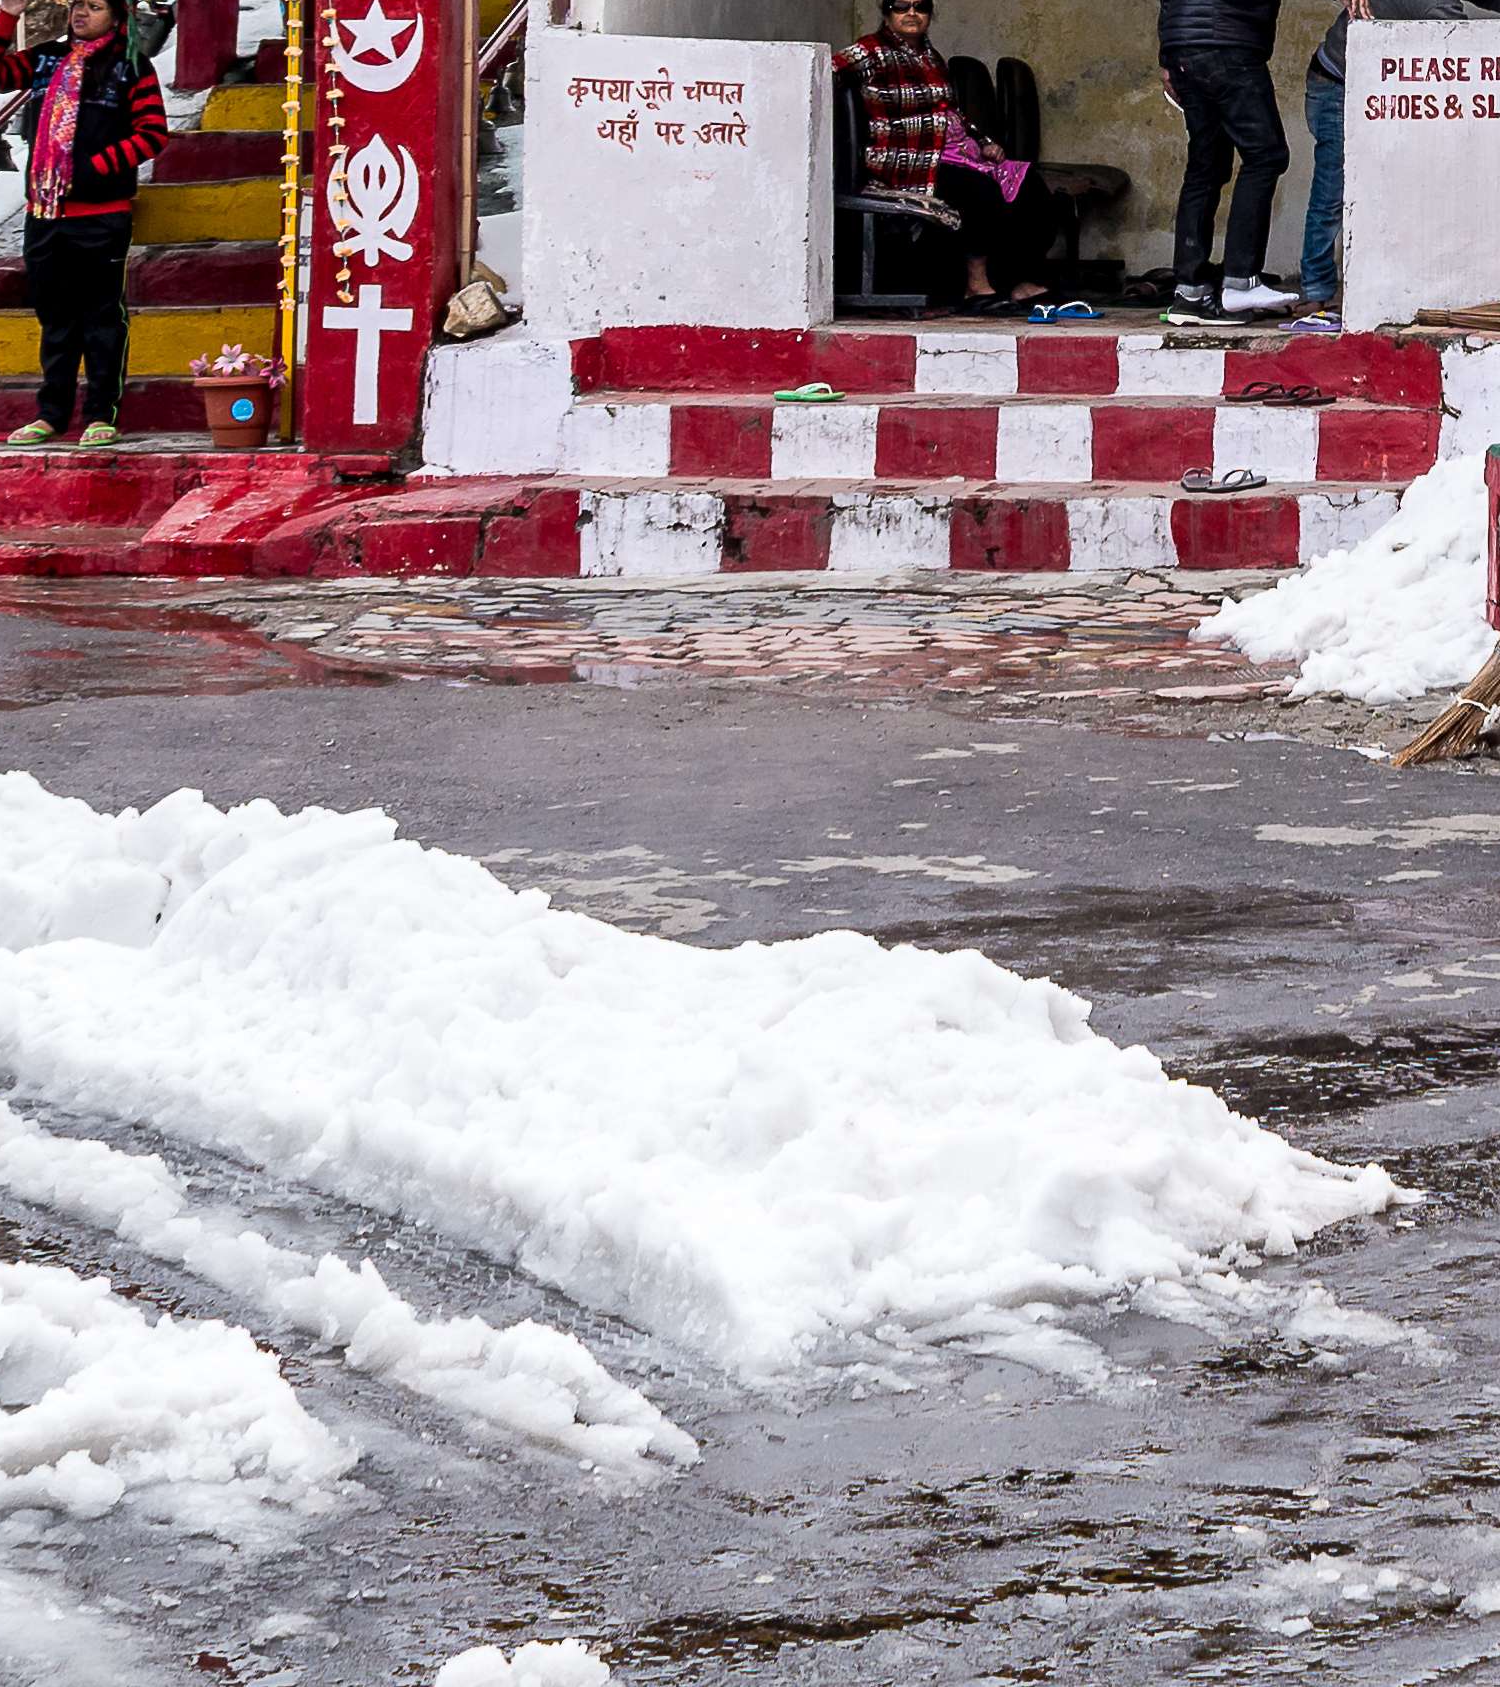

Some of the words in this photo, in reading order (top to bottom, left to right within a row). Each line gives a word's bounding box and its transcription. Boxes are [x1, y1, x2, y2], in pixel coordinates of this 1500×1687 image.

[1381, 57, 1471, 82] PLEASE
[567, 77, 635, 108] कृपया
[637, 67, 675, 110] जूते
[683, 81, 745, 104] चप्पल
[1364, 95, 1440, 121] SHOES
[1444, 95, 1464, 119] &
[654, 121, 686, 146] पर
